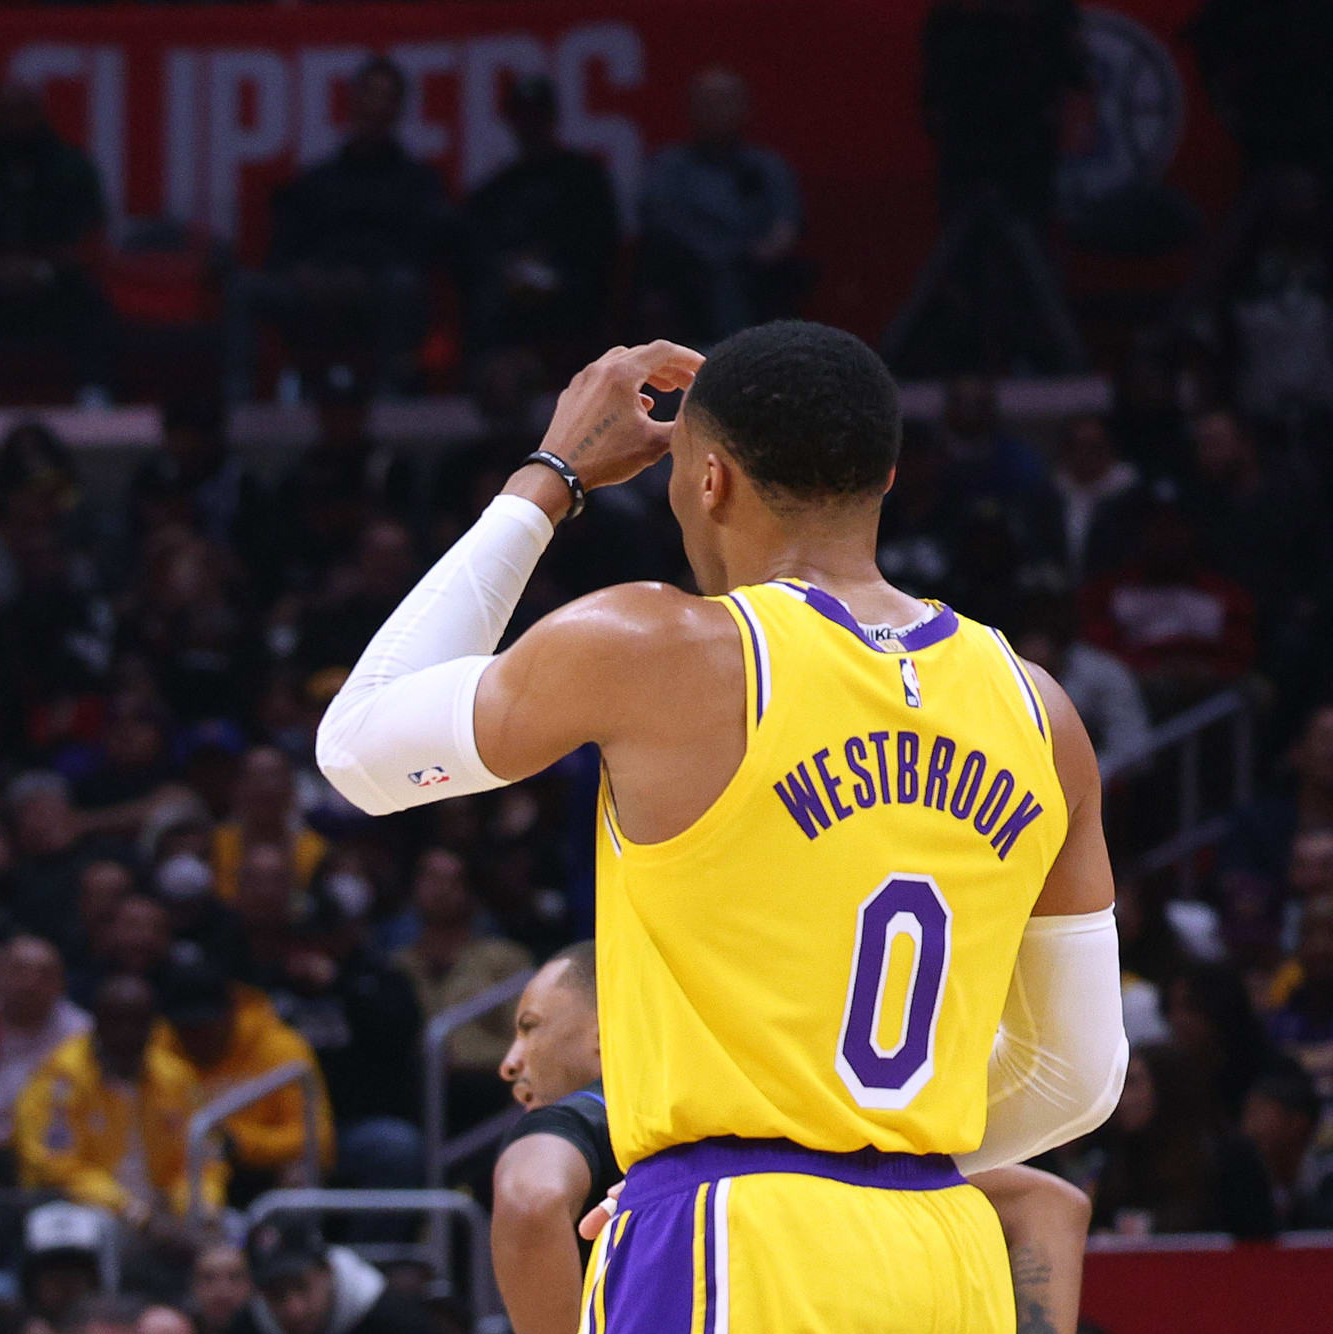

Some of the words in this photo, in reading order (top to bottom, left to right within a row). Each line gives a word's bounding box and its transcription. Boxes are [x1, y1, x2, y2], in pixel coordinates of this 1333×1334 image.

[6, 20, 645, 246] LIPPERS
[773, 730, 1045, 861] WESTBROOK
[834, 871, 953, 1111] 0
